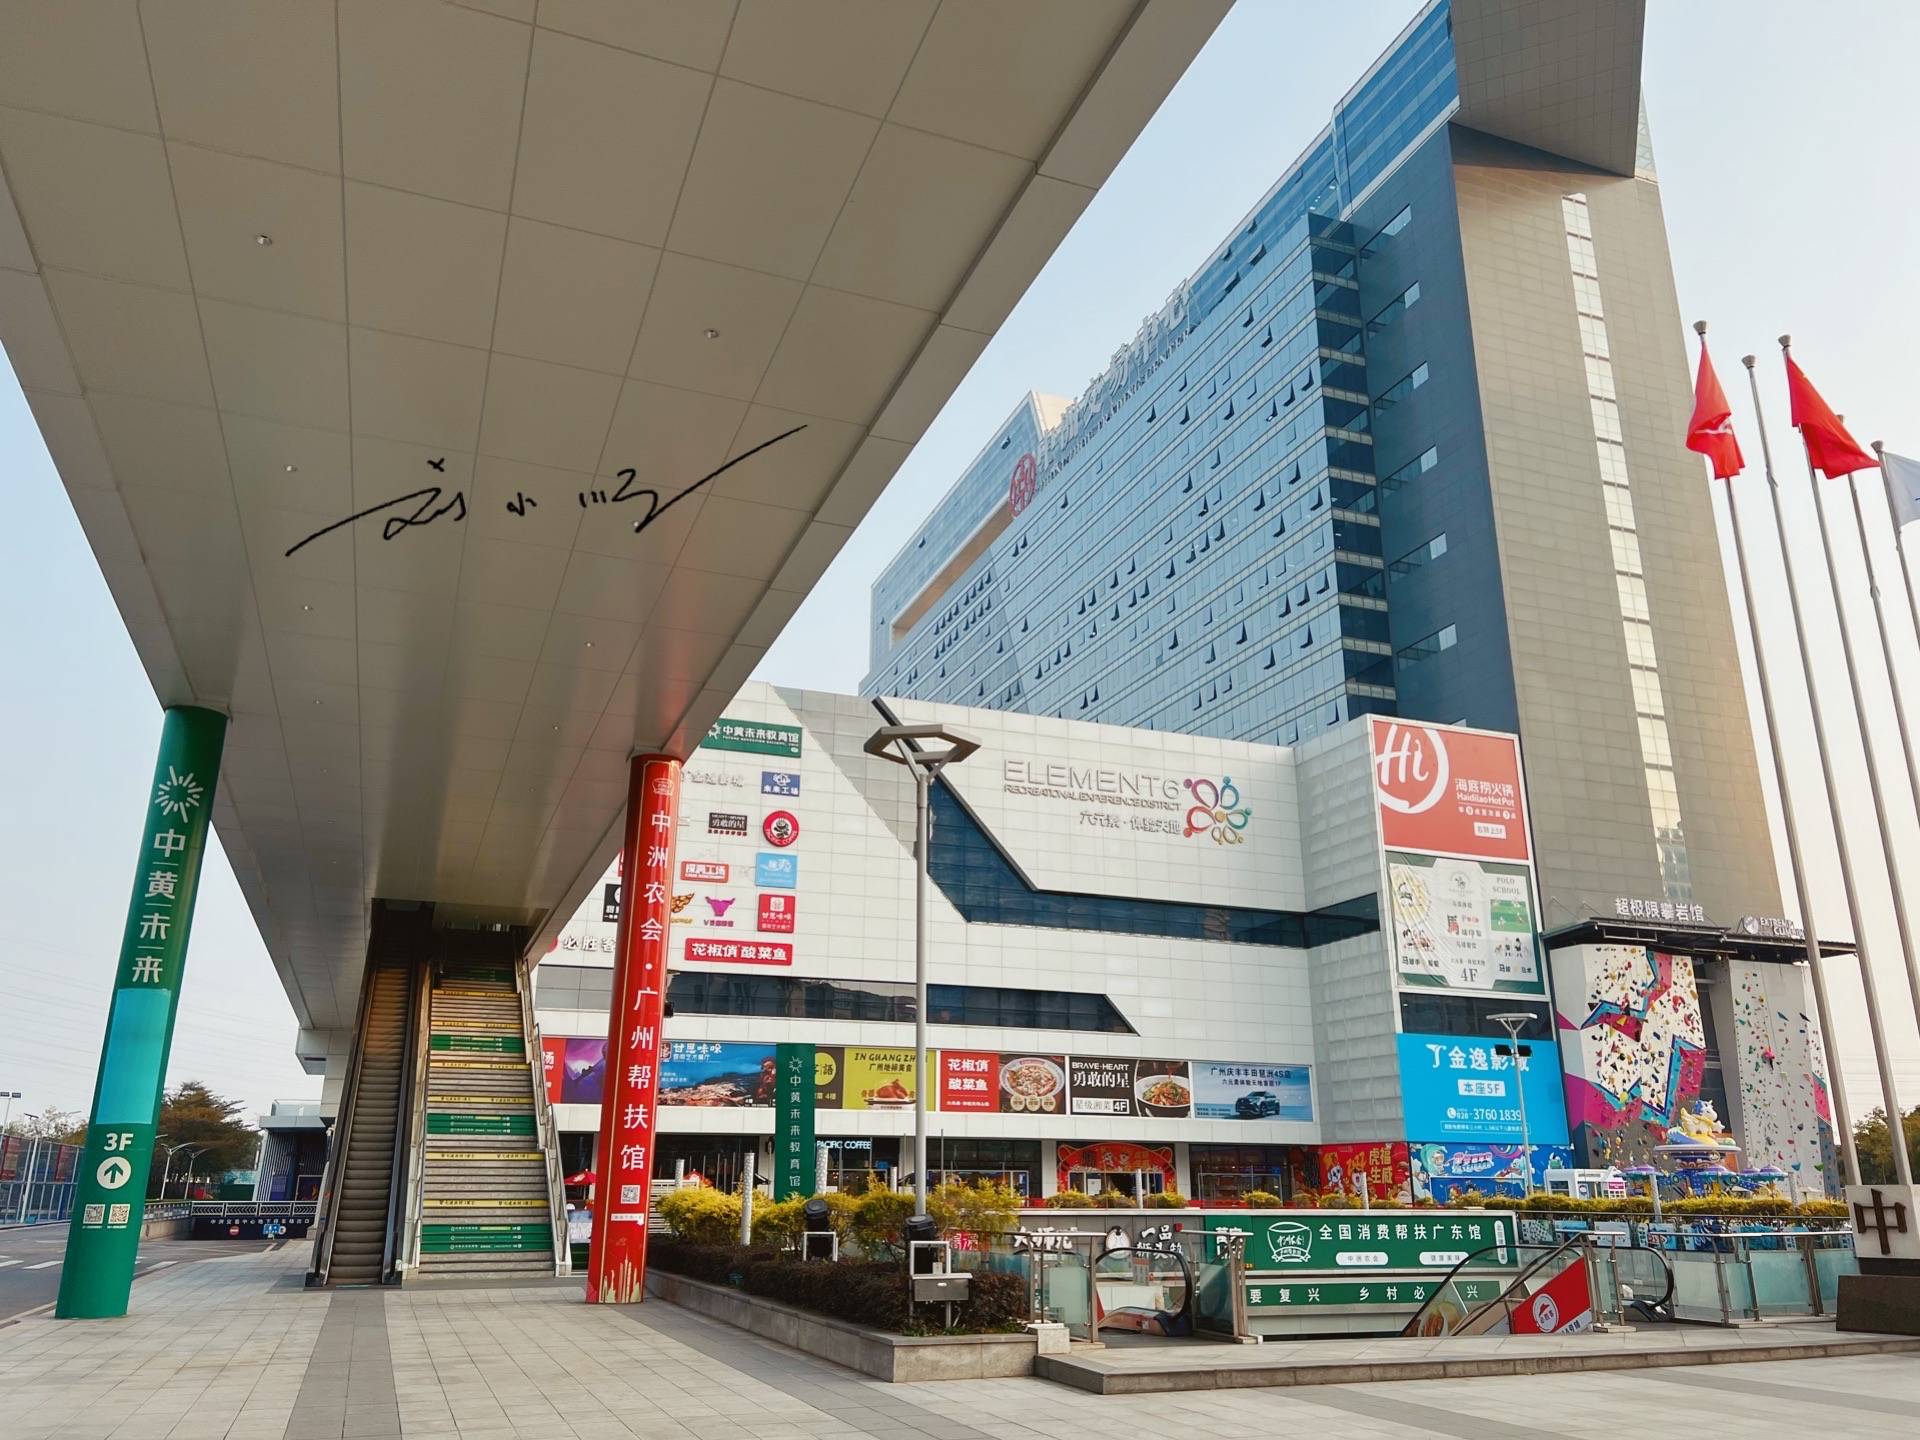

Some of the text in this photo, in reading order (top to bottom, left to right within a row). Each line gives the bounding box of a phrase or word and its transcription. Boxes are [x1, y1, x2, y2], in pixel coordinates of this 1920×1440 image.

[1376, 724, 1429, 786] Hi
[1455, 778, 1514, 797] 海底捞火锅
[1457, 792, 1515, 806] Haidilao Hot Pot
[132, 828, 186, 984] 中黄未来
[1615, 897, 1704, 923] 超极限攀岩馆
[1460, 967, 1478, 983] 4F
[1071, 1062, 1130, 1071] BRAVE-HEART
[947, 1077, 988, 1091] 酸菜鱼
[1072, 1071, 1130, 1088] 勇敢的星
[1463, 1082, 1501, 1095] 本座5F
[1114, 1101, 1127, 1112] 4F
[789, 1075, 801, 1187] 中黄未来教育馆
[103, 1132, 134, 1151] 3F
[816, 1140, 872, 1150] PACIFIC COFFEE
[1853, 1188, 1908, 1256] 中
[1141, 1224, 1172, 1241] 一品
[1319, 1223, 1482, 1241] 全国消费帮扶广东馆
